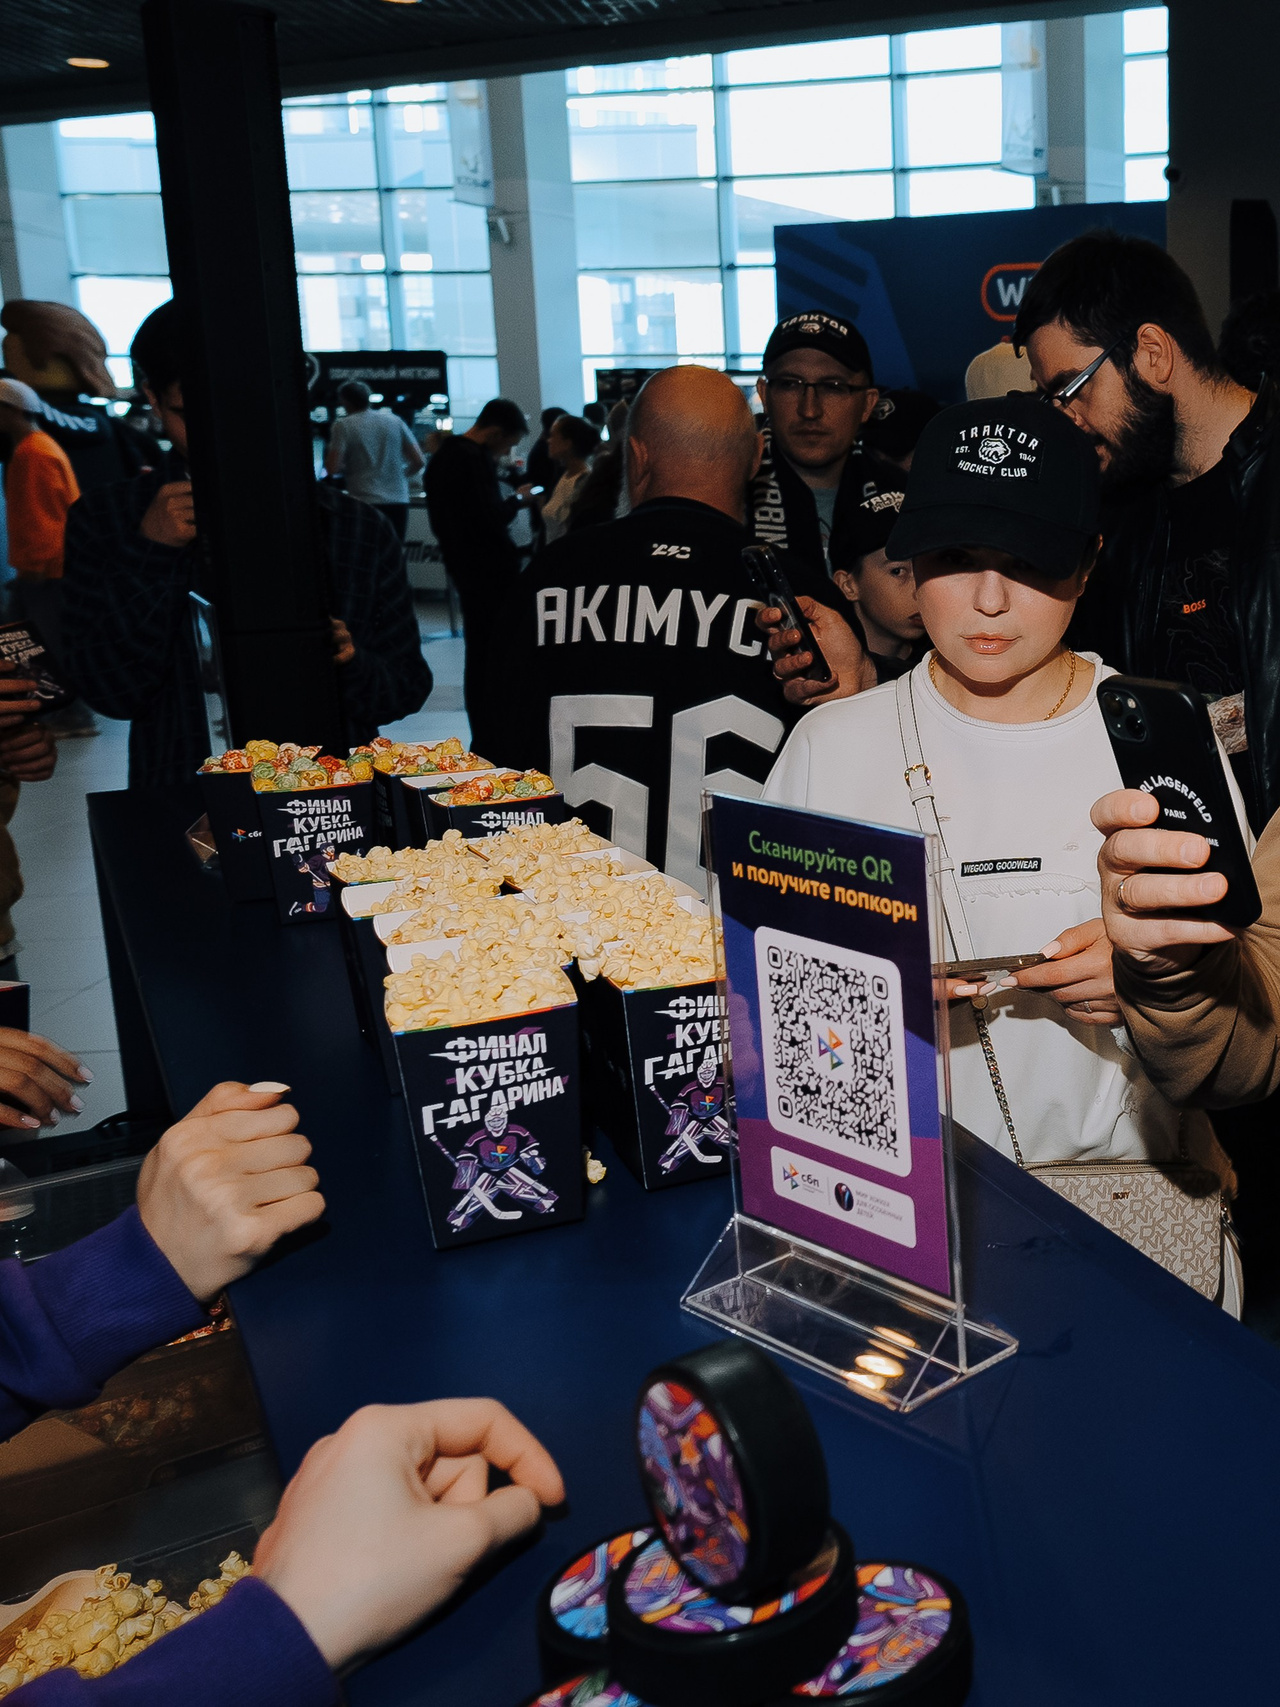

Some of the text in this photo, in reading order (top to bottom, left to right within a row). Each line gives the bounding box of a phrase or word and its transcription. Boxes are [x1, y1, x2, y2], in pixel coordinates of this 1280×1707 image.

[996, 276, 1032, 307] W
[781, 314, 848, 336] TRAKTOR
[959, 424, 1039, 450] TRAKTOR
[955, 446, 971, 454] EST.
[957, 459, 1028, 478] HOCKEY CLUB
[1182, 599, 1207, 614] BOSS
[536, 585, 769, 658] AKIMYC
[277, 799, 352, 816] ФИНАЛ
[1140, 774, 1213, 823] RL LAGERFELD
[293, 814, 357, 835] КУБКА
[471, 811, 545, 829] ФИНАЛ
[1163, 808, 1187, 820] PARIS
[273, 826, 364, 858] ГАГАРИНА
[748, 830, 894, 885] Сканируйте QR
[963, 860, 1039, 874] WEGOOD GOODWEAR
[732, 861, 918, 924] и получите попкорн
[430, 1033, 547, 1063] ФИНАЛ
[455, 1056, 555, 1095] КУБКА
[422, 1075, 565, 1135] ГАГАРИНА
[801, 1173, 820, 1188] сбп
